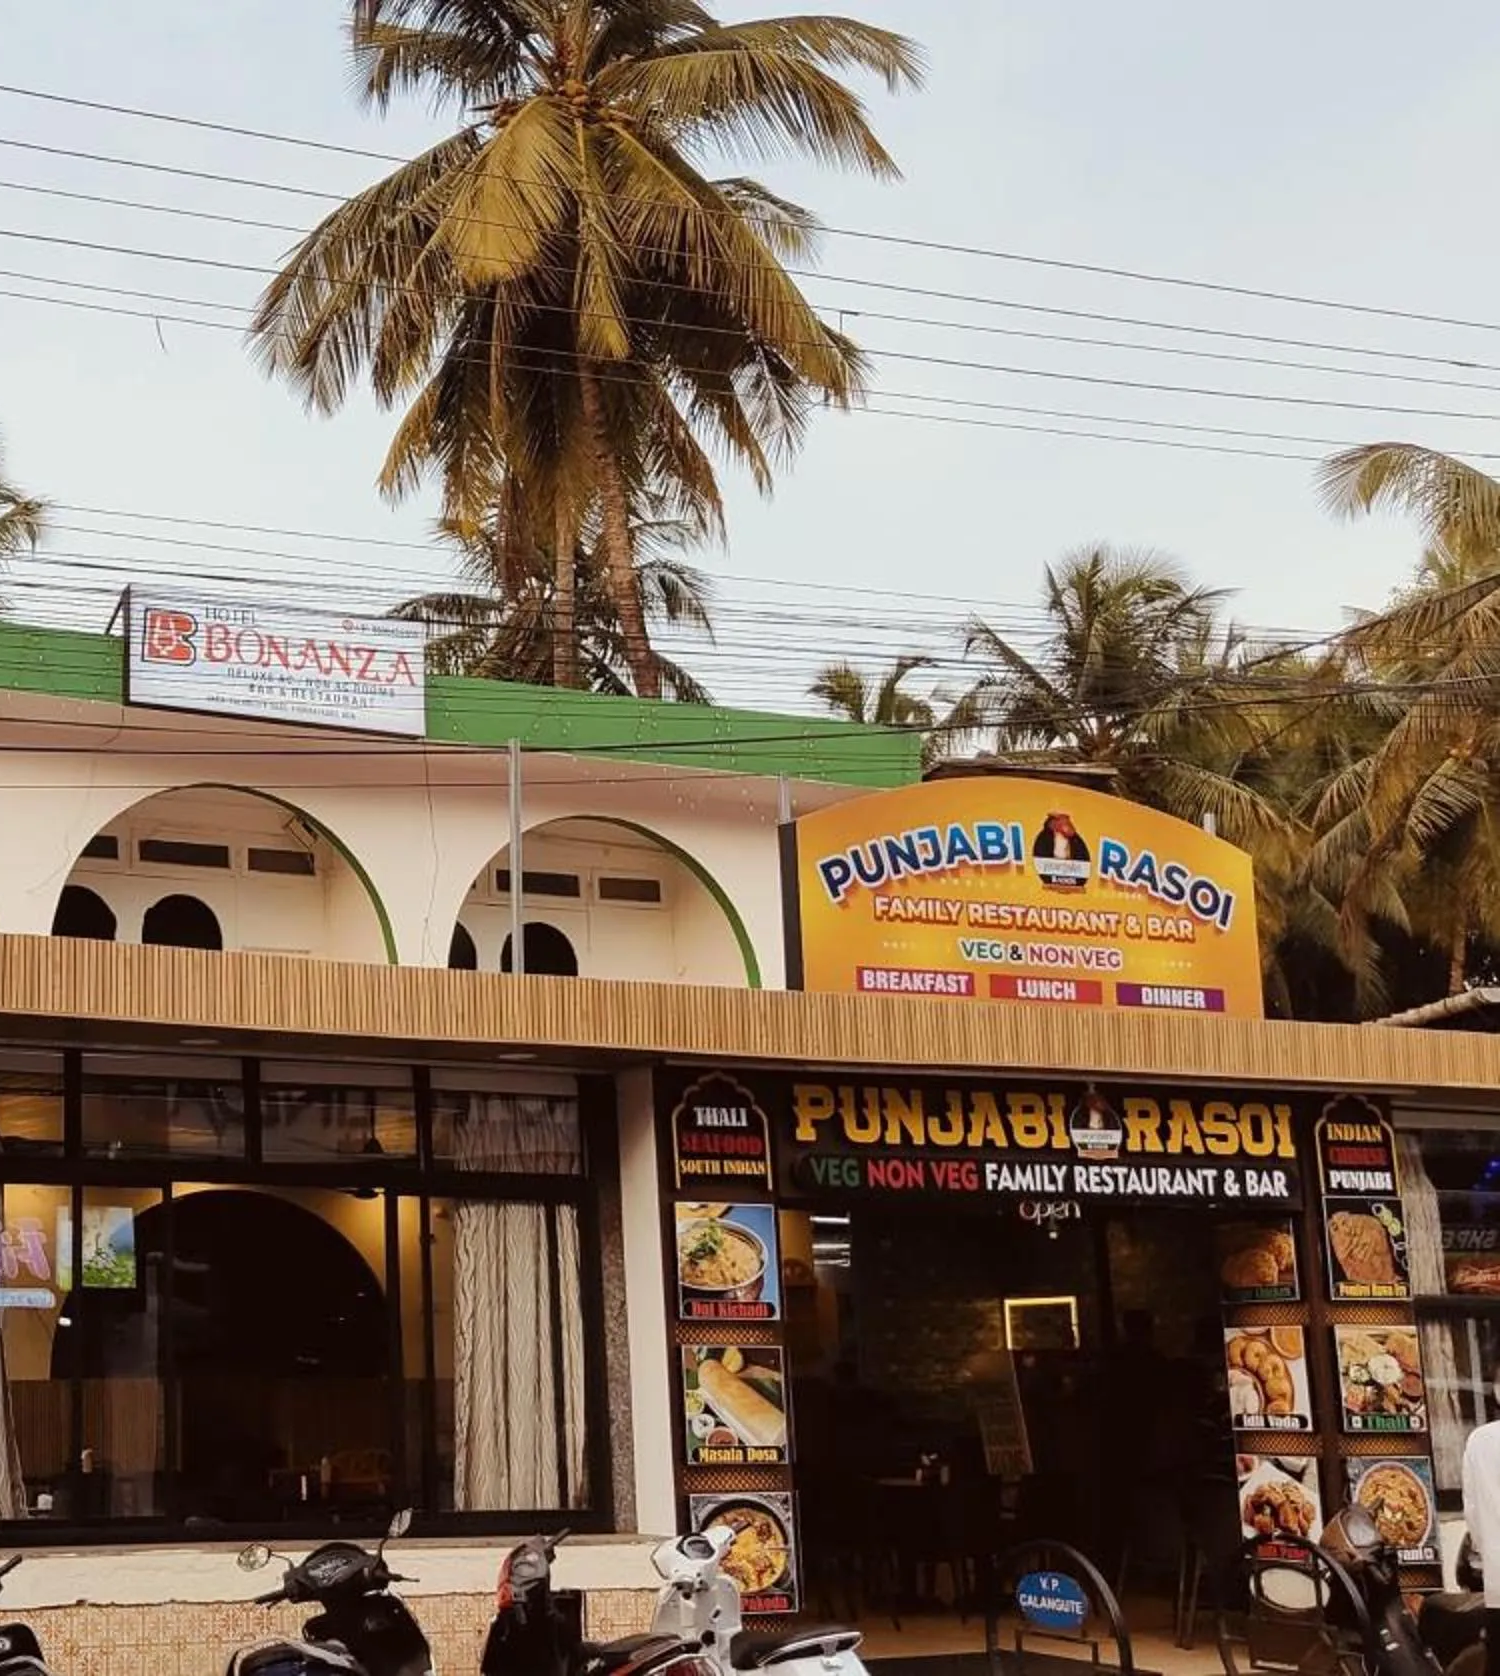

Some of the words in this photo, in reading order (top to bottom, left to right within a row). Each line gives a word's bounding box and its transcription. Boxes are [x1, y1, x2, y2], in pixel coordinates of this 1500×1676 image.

[203, 622, 416, 687] BONANZA
[819, 823, 1024, 902] PUNJABI
[1099, 839, 1235, 928] RASOI
[874, 896, 963, 926] FAMILY
[968, 905, 1121, 935] RESTAURANT
[1125, 916, 1142, 935] &
[1147, 918, 1196, 941] BAR
[961, 941, 1003, 961] VEG
[1008, 945, 1023, 962] &
[1029, 946, 1075, 966] NON
[1081, 949, 1122, 969] VEG
[862, 971, 969, 995] BREAKFAST
[1016, 979, 1077, 1001] LUNCH
[1140, 987, 1206, 1009] DINNER
[694, 1107, 748, 1127] THALI
[793, 1084, 1071, 1150] PUNJABI
[1122, 1097, 1296, 1159] RASOI
[1326, 1122, 1382, 1143] INDIAN
[679, 1159, 721, 1175] SOUTH
[723, 1160, 765, 1176] INDIAN
[809, 1157, 861, 1187] VEG
[867, 1159, 925, 1188] NON
[929, 1161, 979, 1191] VEG
[985, 1163, 1067, 1193] FAMILY
[1075, 1166, 1218, 1197] RESTAURANT
[1223, 1170, 1241, 1197] &
[1246, 1170, 1289, 1198] BAR
[1329, 1169, 1393, 1191] PUNJABI
[1018, 1200, 1081, 1226] Open
[1365, 1414, 1408, 1429] Thali
[698, 1447, 744, 1462] Masala
[747, 1447, 778, 1461] Dosa
[1019, 1593, 1085, 1615] CALANGUTE
